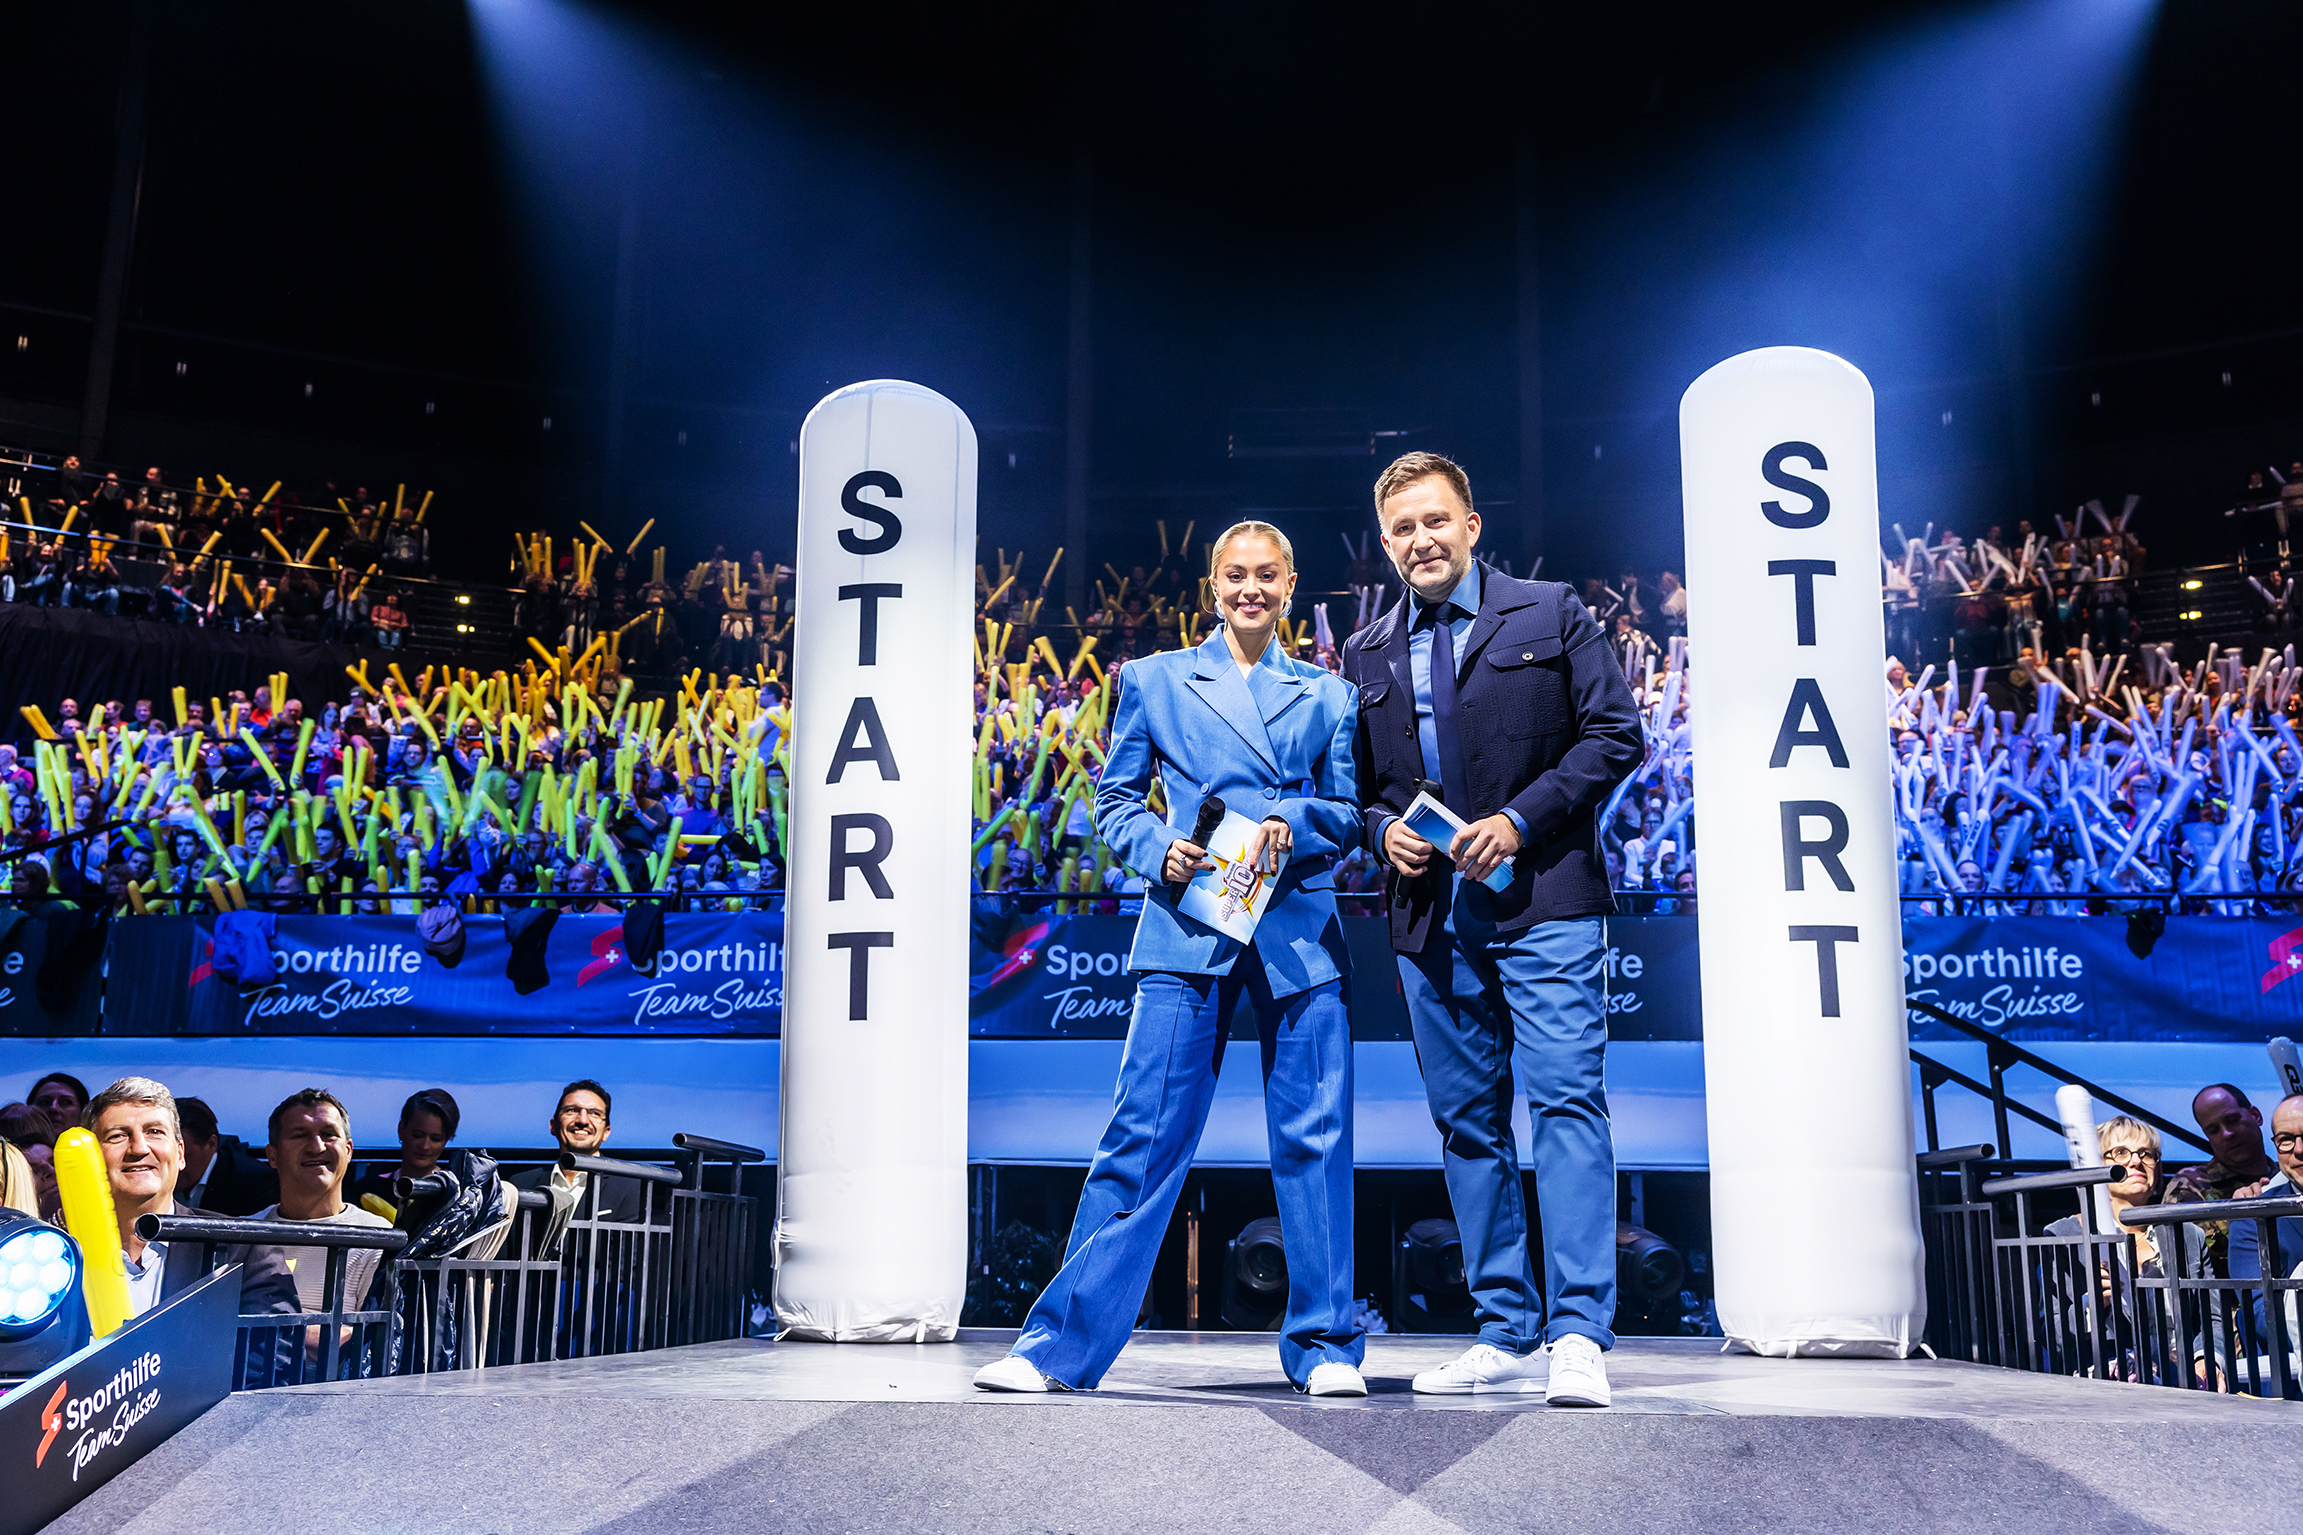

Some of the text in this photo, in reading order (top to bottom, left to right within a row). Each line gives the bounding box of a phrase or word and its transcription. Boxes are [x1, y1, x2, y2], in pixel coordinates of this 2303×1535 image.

[825, 470, 903, 1021] START
[1761, 441, 1859, 1018] START
[239, 979, 414, 1026] Team Suisse
[628, 982, 715, 1026] Team
[1043, 986, 1131, 1029] Team
[1981, 984, 2084, 1027] Suisse
[66, 1351, 161, 1431] Sporthilfe
[66, 1388, 161, 1482] Team Suisse
